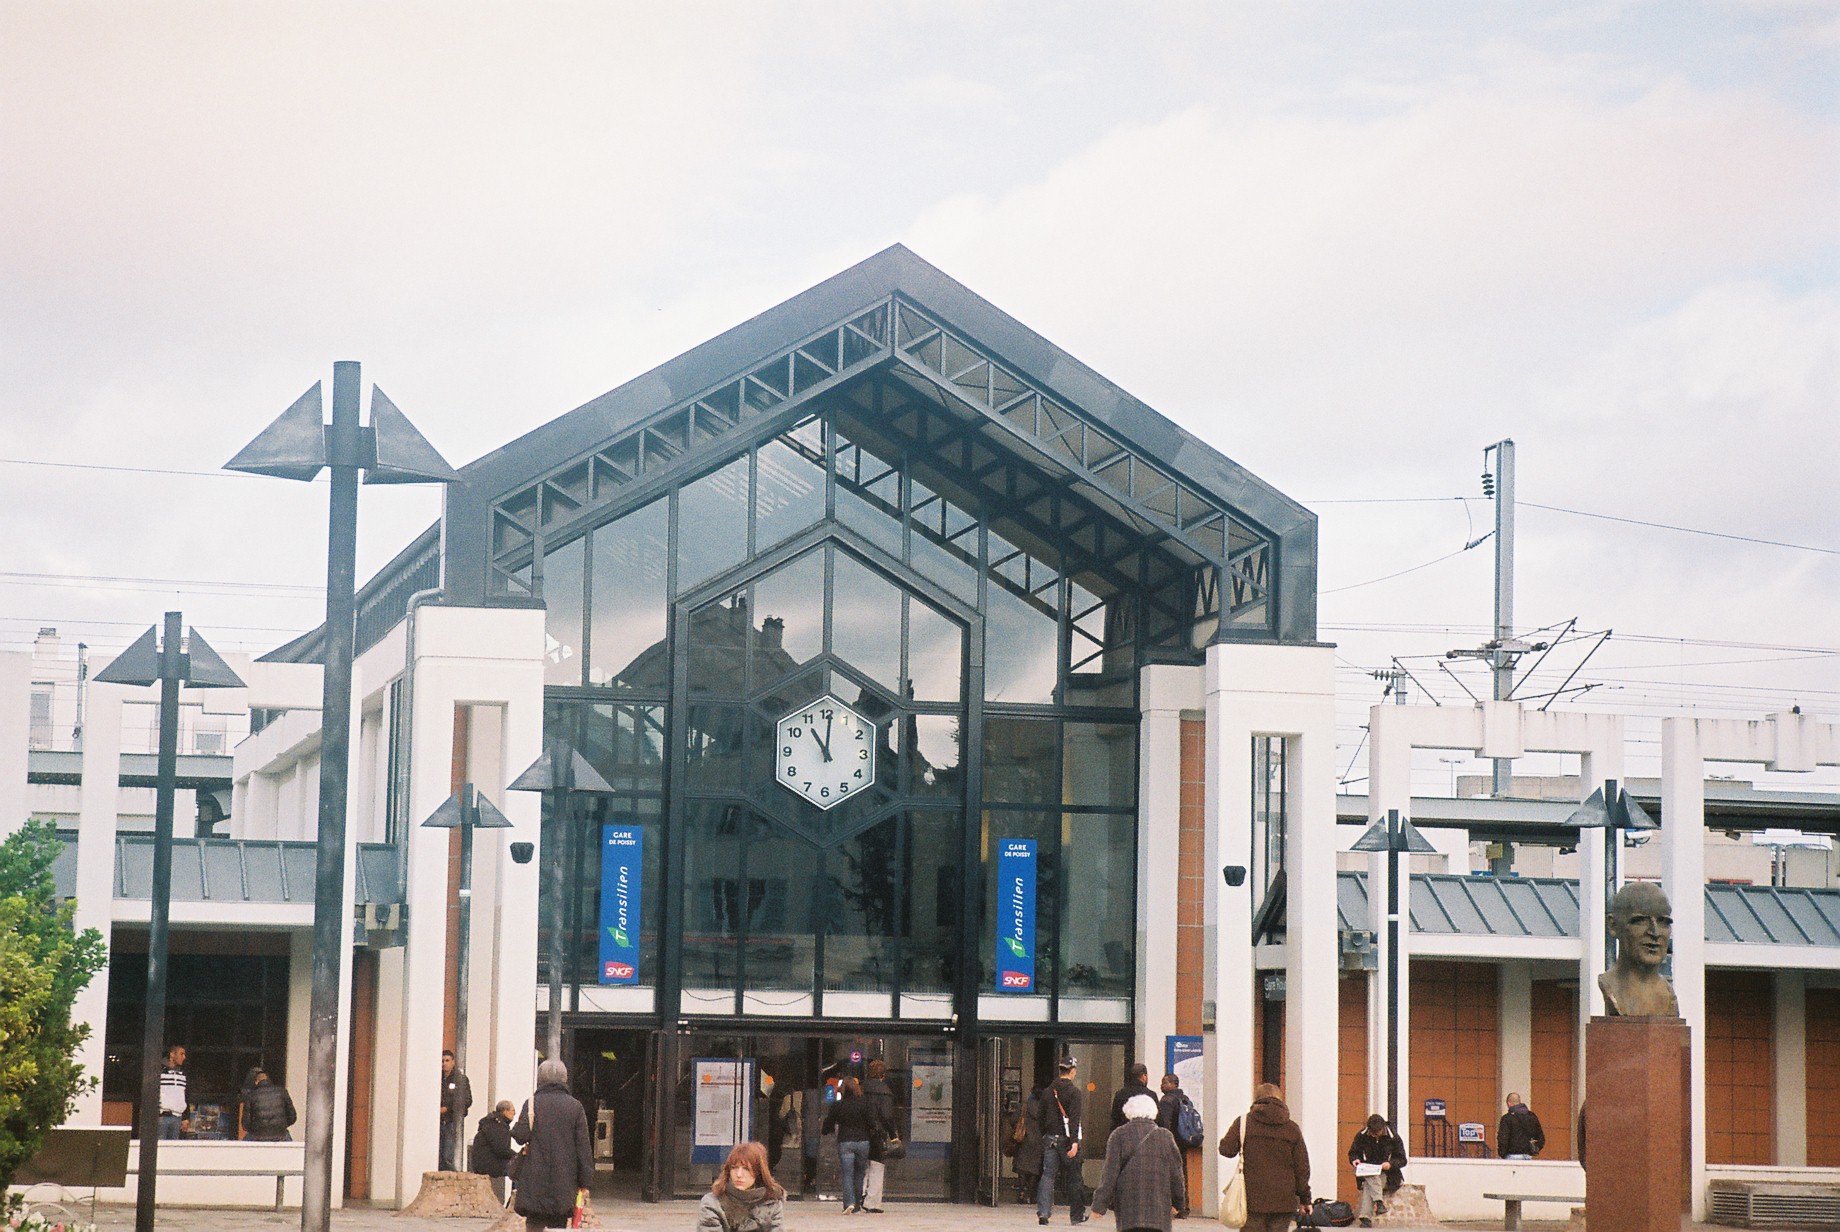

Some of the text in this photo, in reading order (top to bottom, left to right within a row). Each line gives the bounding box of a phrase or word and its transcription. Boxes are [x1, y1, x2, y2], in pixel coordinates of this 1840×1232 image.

[802, 714, 814, 724] 11
[819, 709, 834, 720] 12
[842, 715, 849, 726] 1
[787, 727, 802, 738] 10
[855, 730, 864, 740] 2
[783, 746, 792, 757] 9
[859, 750, 868, 760] 3
[787, 766, 797, 777] 8
[854, 769, 863, 779] 4
[803, 782, 812, 792] 7
[820, 787, 830, 798] 6
[840, 782, 849, 793] 5
[613, 831, 633, 839] GARE
[615, 866, 629, 941] Transilien
[1012, 877, 1024, 951] Transilien
[605, 967, 633, 976] SNCF
[1003, 976, 1029, 985] SNCF
